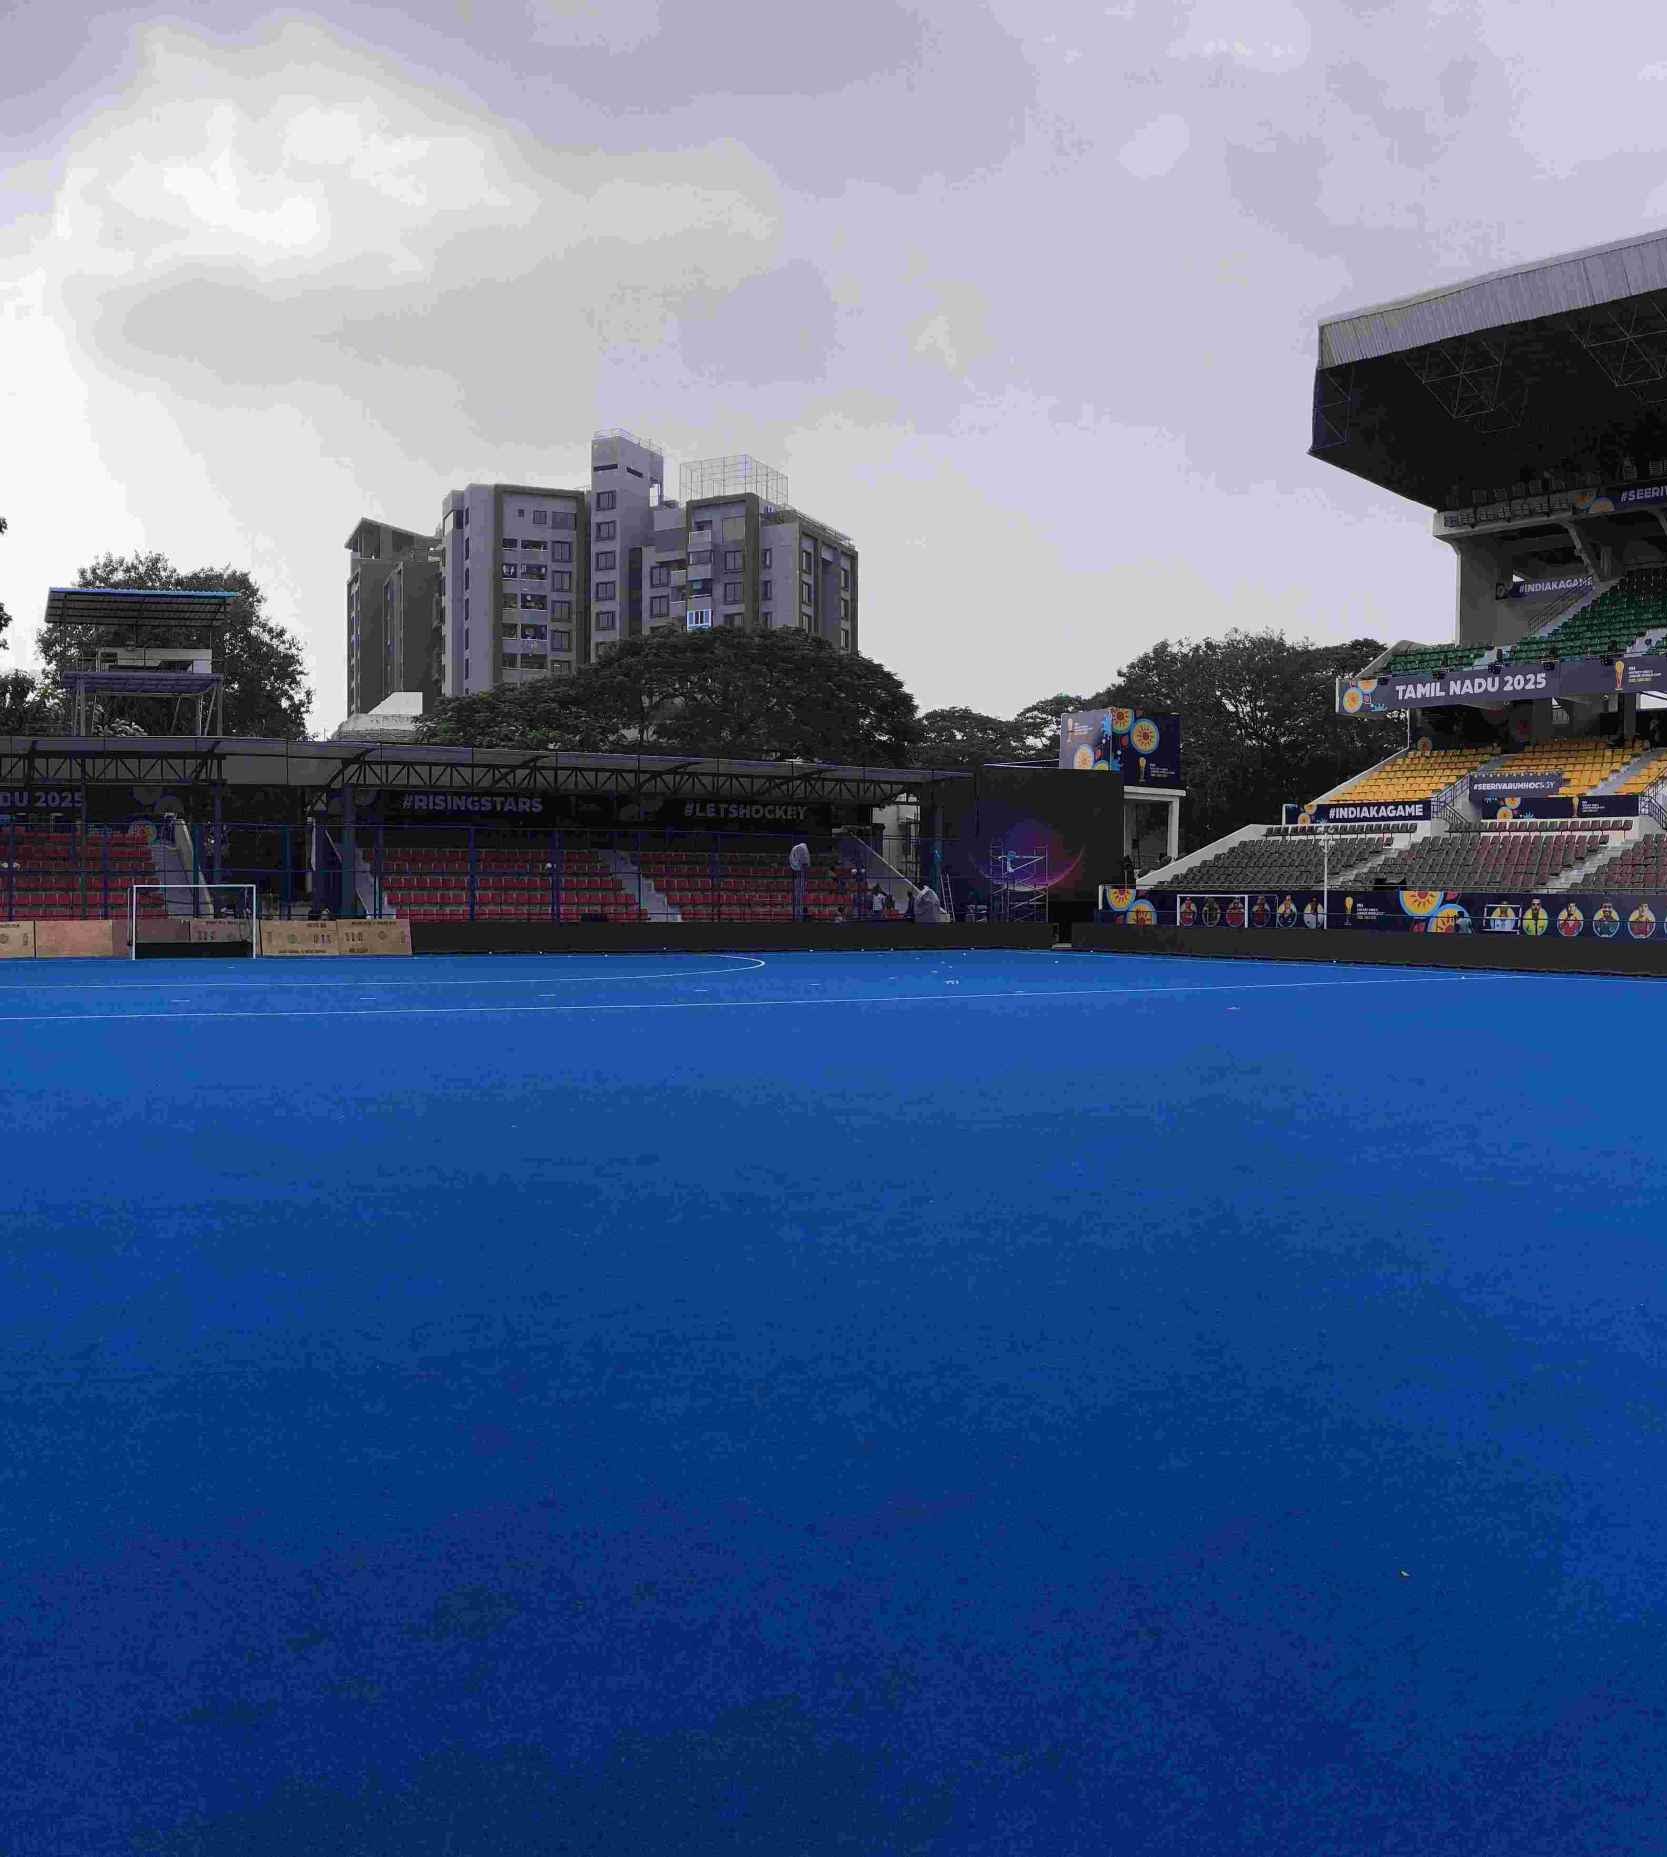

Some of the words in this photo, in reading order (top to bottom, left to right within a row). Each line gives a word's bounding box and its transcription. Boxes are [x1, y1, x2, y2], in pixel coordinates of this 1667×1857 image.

[1395, 680, 1446, 701] TAMIL
[1449, 676, 1500, 697] NADU
[1503, 673, 1547, 692] 2025
[33, 791, 83, 808] 2025
[400, 793, 544, 814] #RISINGSTARS
[684, 800, 809, 820] #LETSHOCKEY
[1328, 804, 1424, 820] #INDIAKAGAME
